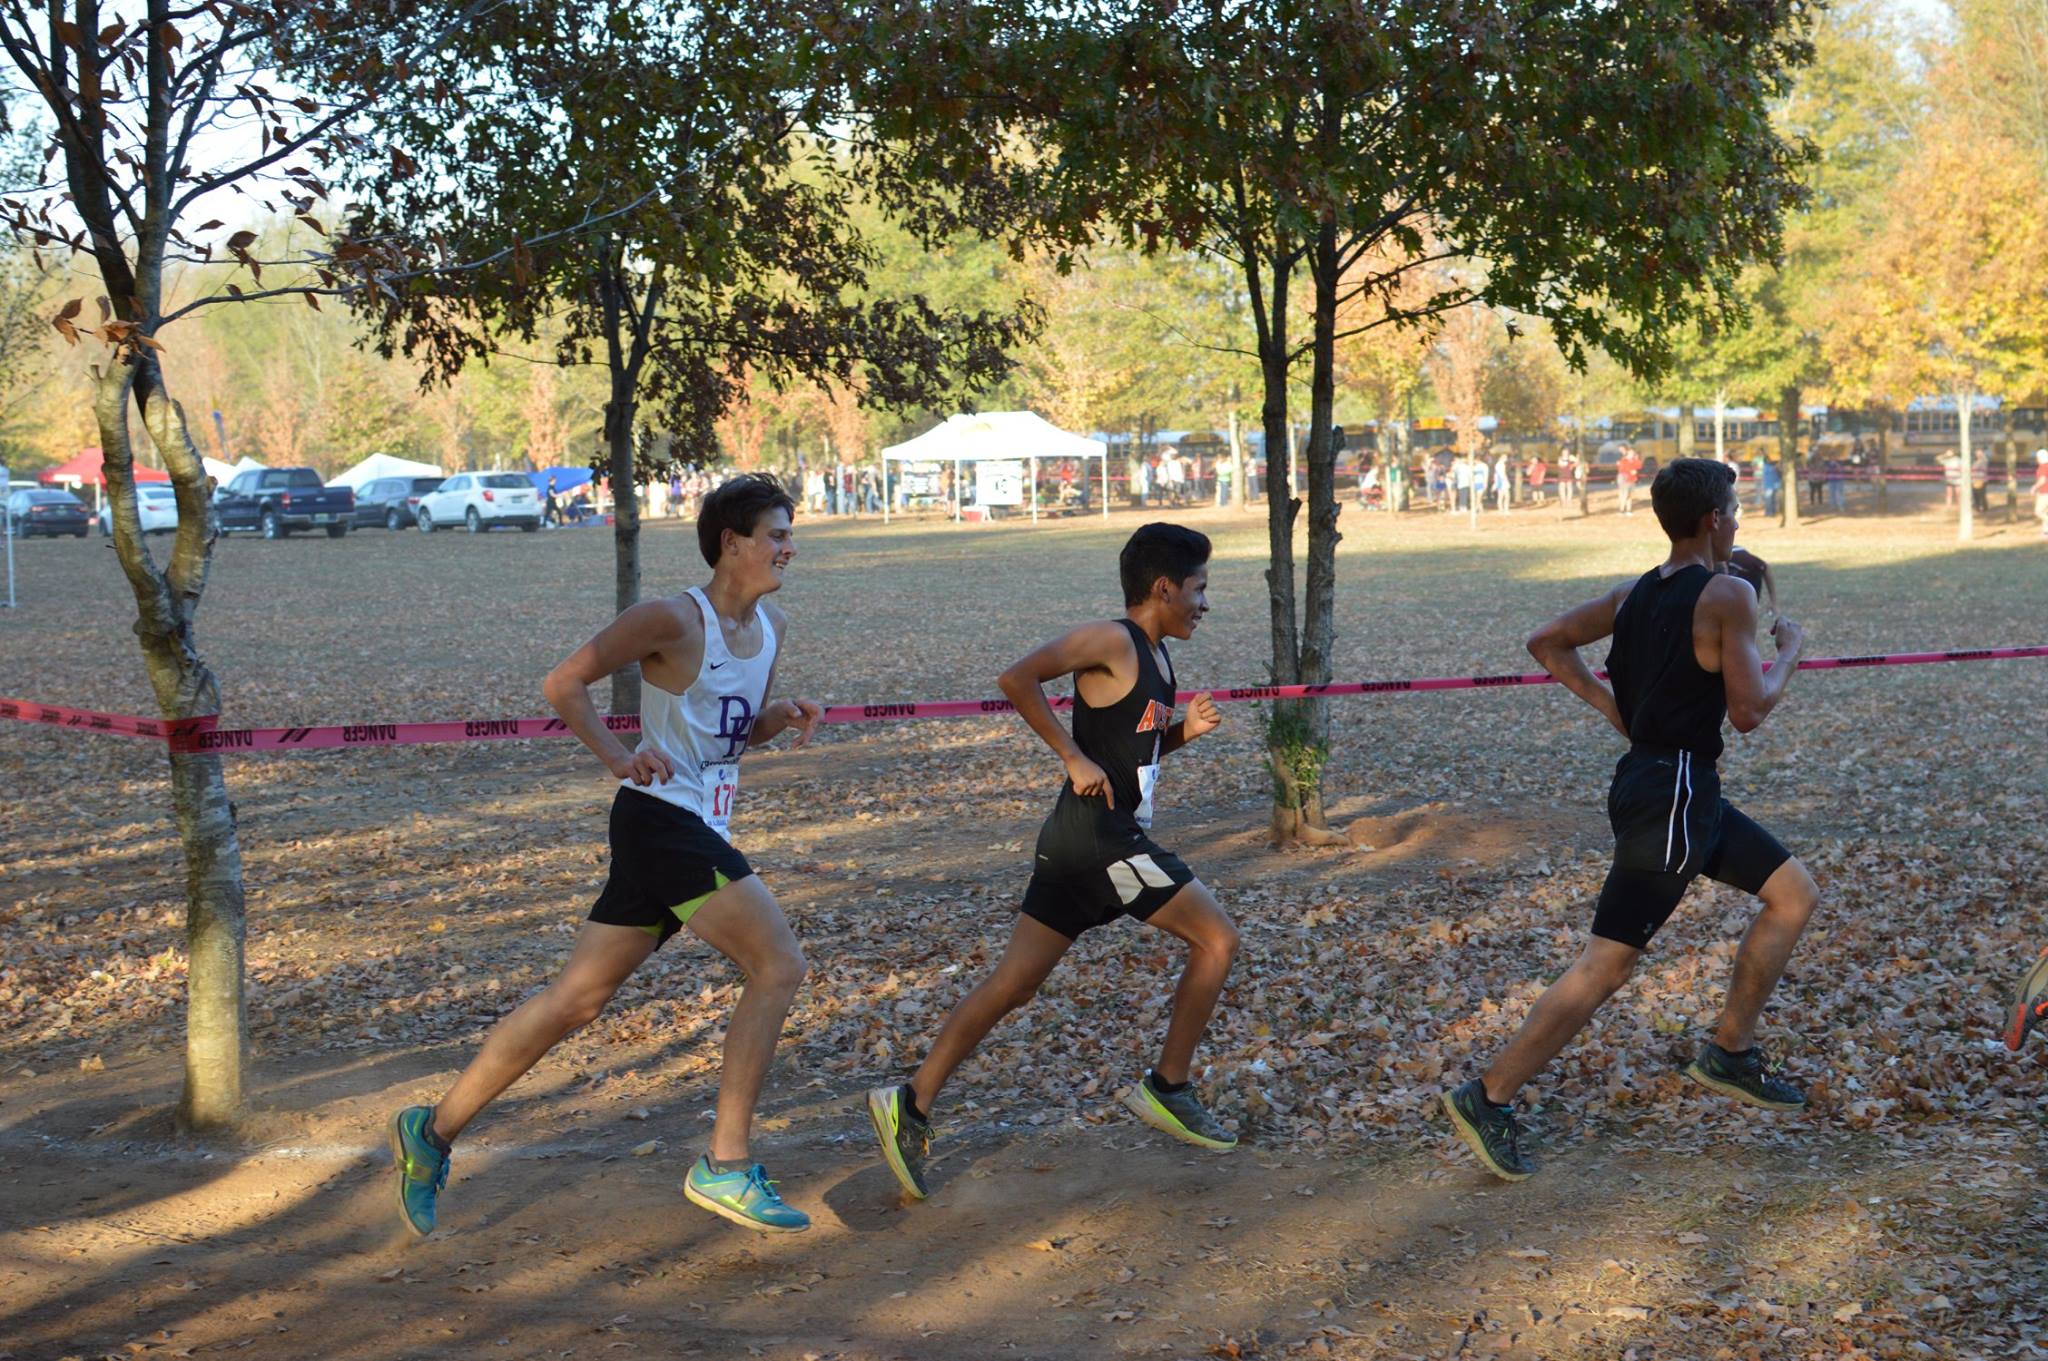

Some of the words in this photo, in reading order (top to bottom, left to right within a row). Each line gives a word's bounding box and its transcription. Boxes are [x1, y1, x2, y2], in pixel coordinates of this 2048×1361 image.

[864, 703, 916, 718] DANGER
[981, 700, 1015, 712] NGER
[465, 720, 518, 738] DANGER
[606, 715, 641, 731] NGER
[200, 730, 253, 748] DANGER
[343, 724, 396, 742] DANGER
